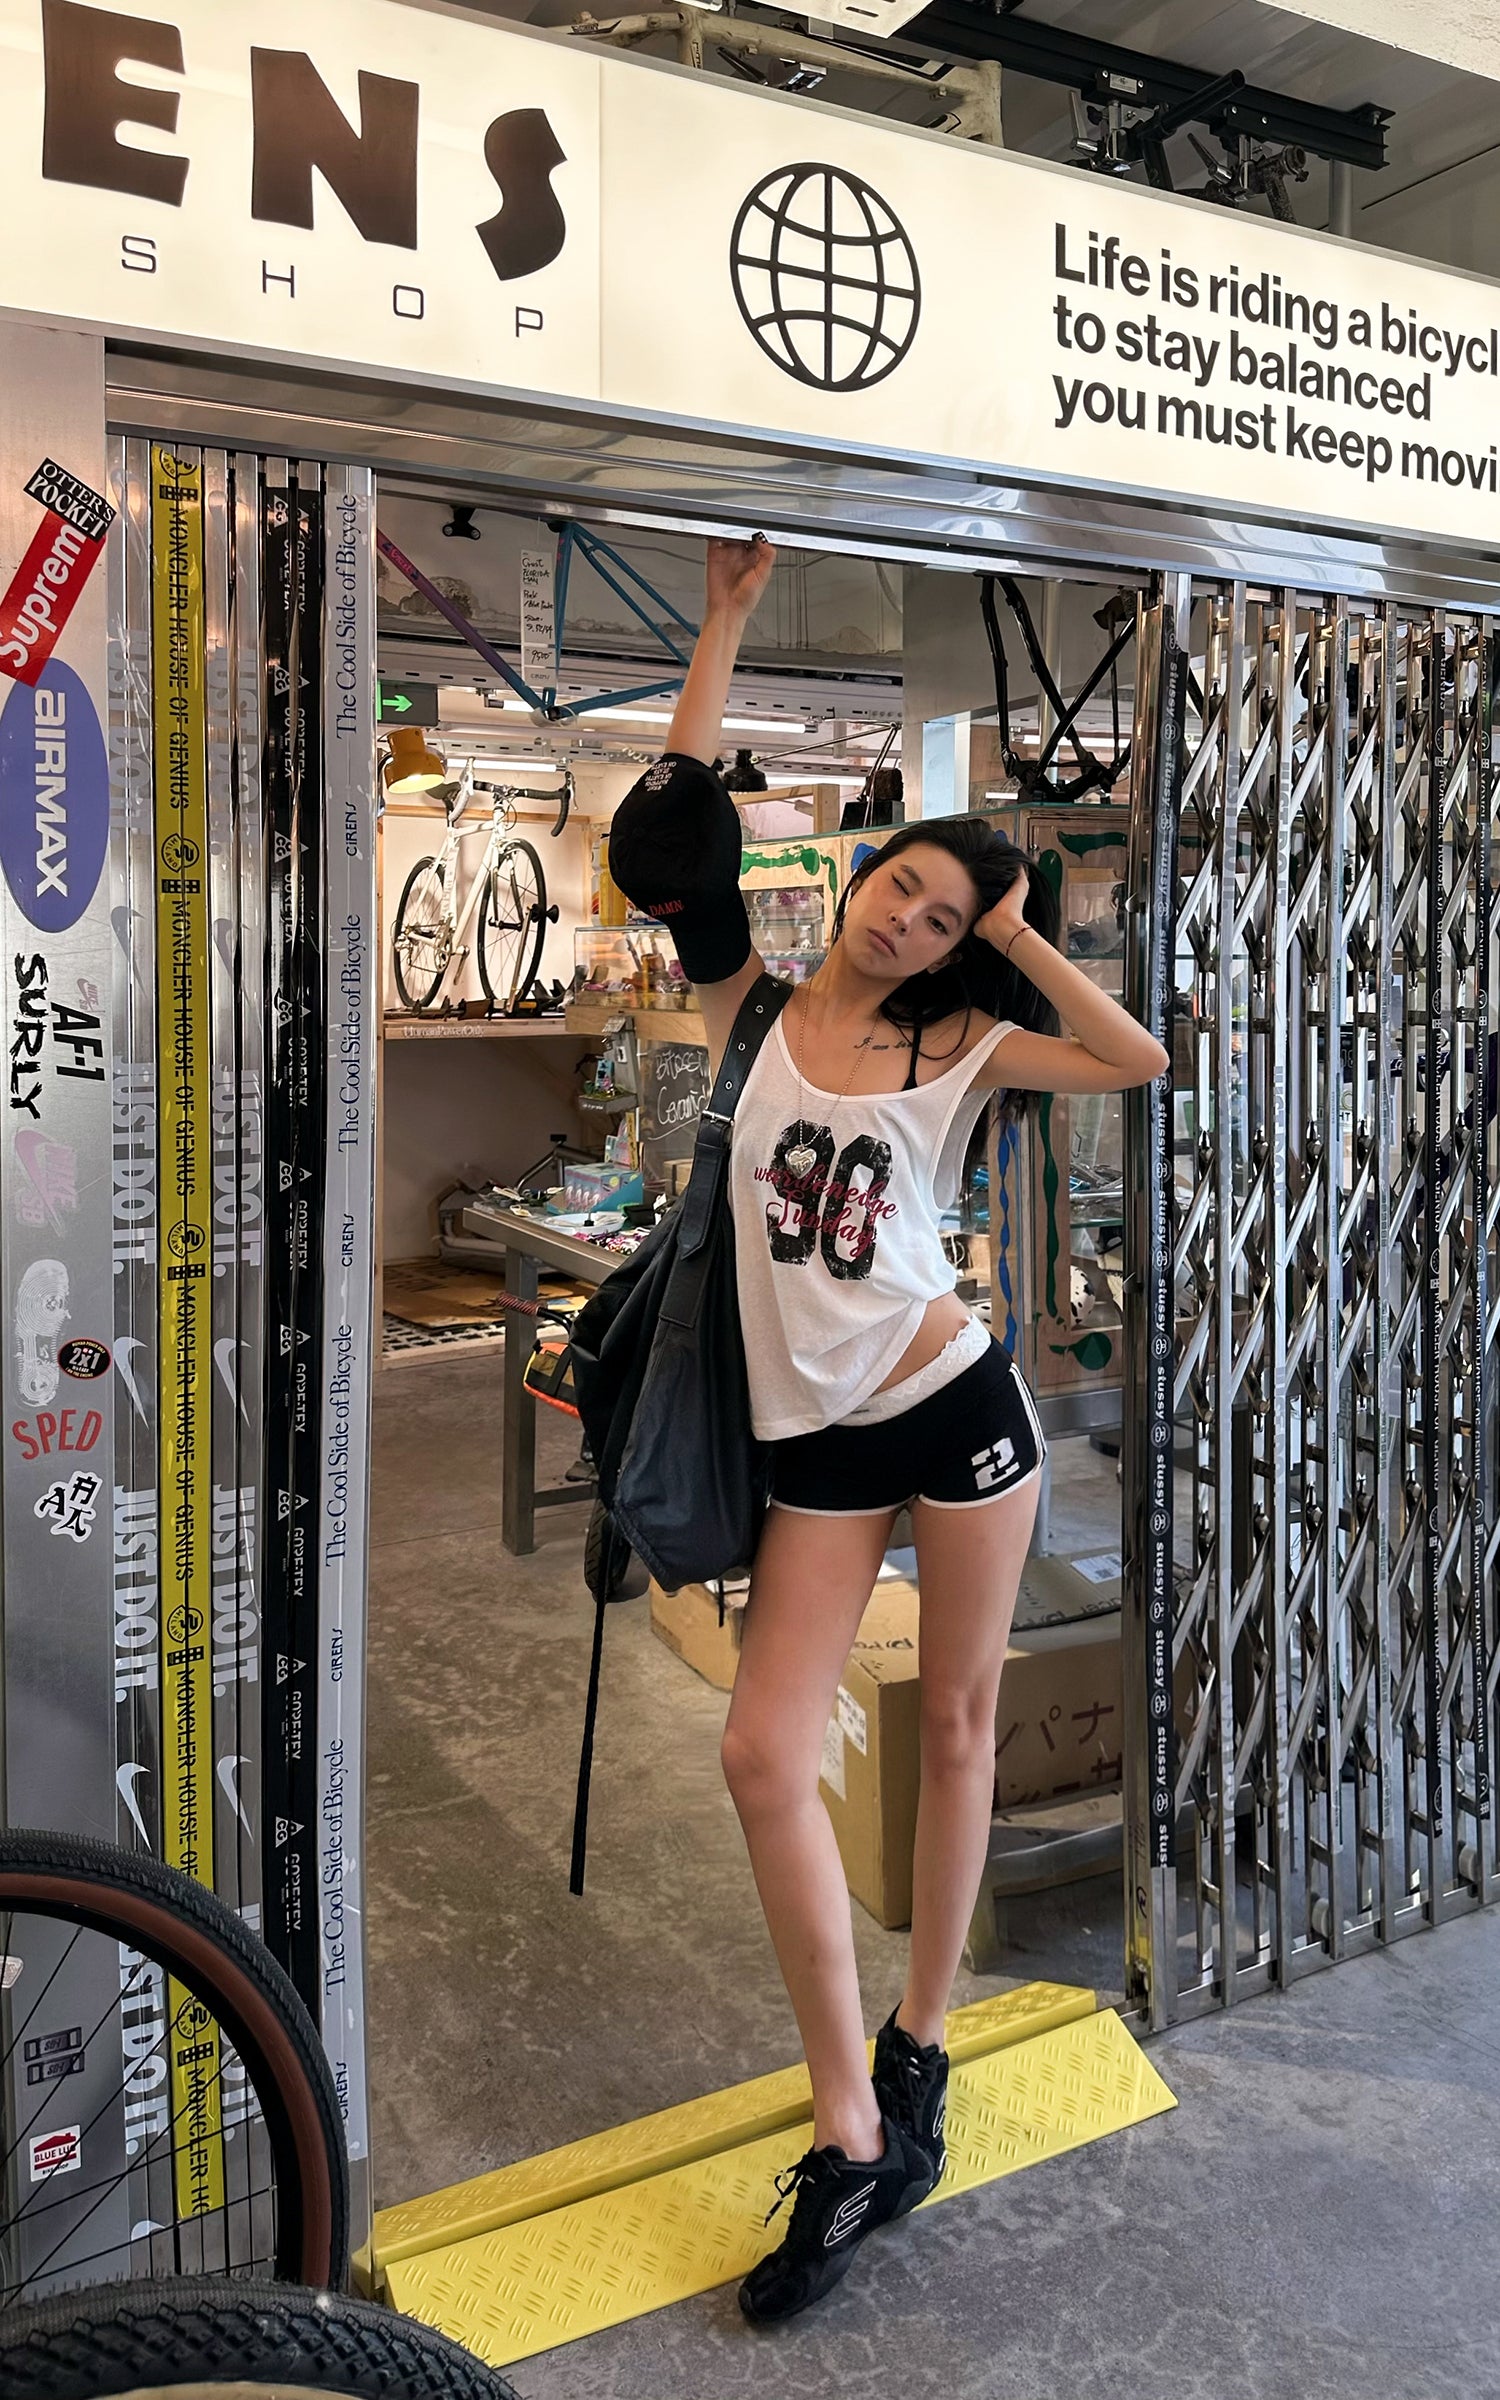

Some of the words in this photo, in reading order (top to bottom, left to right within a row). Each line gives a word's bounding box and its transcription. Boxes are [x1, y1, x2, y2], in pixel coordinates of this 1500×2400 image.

[42, 0, 568, 282] ENS
[121, 234, 544, 338] SHOP
[1055, 222, 1151, 297] Life
[1161, 248, 1199, 307] is
[1210, 265, 1339, 350] riding
[1348, 309, 1372, 348] a
[1053, 295, 1106, 353] to
[1115, 315, 1220, 387] stay
[1230, 330, 1431, 420] balanced
[1053, 375, 1146, 429] you
[1158, 394, 1276, 454] must
[1286, 406, 1393, 482] keep
[29, 475, 108, 538] POCKET
[42, 463, 114, 522] OTTER'S
[335, 494, 361, 565] Bicycle
[168, 507, 189, 610] MONCLER
[335, 566, 357, 592] of
[336, 594, 358, 639] Side
[169, 616, 189, 689] HOUSE
[336, 642, 358, 691] Cool
[169, 695, 189, 724] OF
[336, 695, 357, 740] The
[169, 732, 190, 810] GENIUS
[172, 900, 193, 1000] MONCLER
[340, 914, 367, 983] Bicycle
[340, 985, 362, 1008] of
[9, 952, 49, 1119] SURLY
[173, 1008, 194, 1078] HOUSE
[340, 1011, 361, 1054] Side
[175, 1085, 195, 1114] OF
[339, 1058, 361, 1104] Cool
[338, 1107, 359, 1153] The
[1157, 1102, 1169, 1156] stussy
[175, 1120, 195, 1197] GENIUS
[1157, 1189, 1168, 1244] stussy
[1156, 1278, 1169, 1332] stussy
[69, 1347, 101, 1370] 2x1
[176, 1285, 196, 1387] MONCLER
[330, 1324, 354, 1394] Bicycle
[329, 1396, 351, 1419] of
[1156, 1365, 1168, 1420] stussy
[12, 1409, 103, 1461] SPED
[176, 1391, 196, 1462] HOUSE
[328, 1421, 350, 1467] Side
[176, 1469, 196, 1498] OF
[326, 1471, 348, 1517] Cool
[1155, 1453, 1167, 1508] stussy
[114, 1484, 157, 1578] JUST
[175, 1504, 195, 1582] GENIUS
[212, 1484, 256, 1574] JUST
[325, 1520, 347, 1567] The
[1154, 1541, 1167, 1596] stussy
[114, 1583, 158, 1649] DO
[213, 1579, 258, 1645] DO
[115, 1651, 159, 1703] IT.
[213, 1645, 259, 1698] IT.
[1154, 1629, 1167, 1688] stussy
[176, 1669, 197, 1769] MONCLER
[324, 1739, 348, 1810] Bicycle
[1156, 1725, 1170, 1786] stussy
[178, 1774, 199, 1846] HOUSE
[323, 1812, 346, 1833] of
[324, 1836, 345, 1885] Side
[323, 1890, 346, 1941] Cool
[325, 1944, 346, 1996] The
[123, 2019, 168, 2094] DO
[34, 2150, 57, 2163] BLUE
